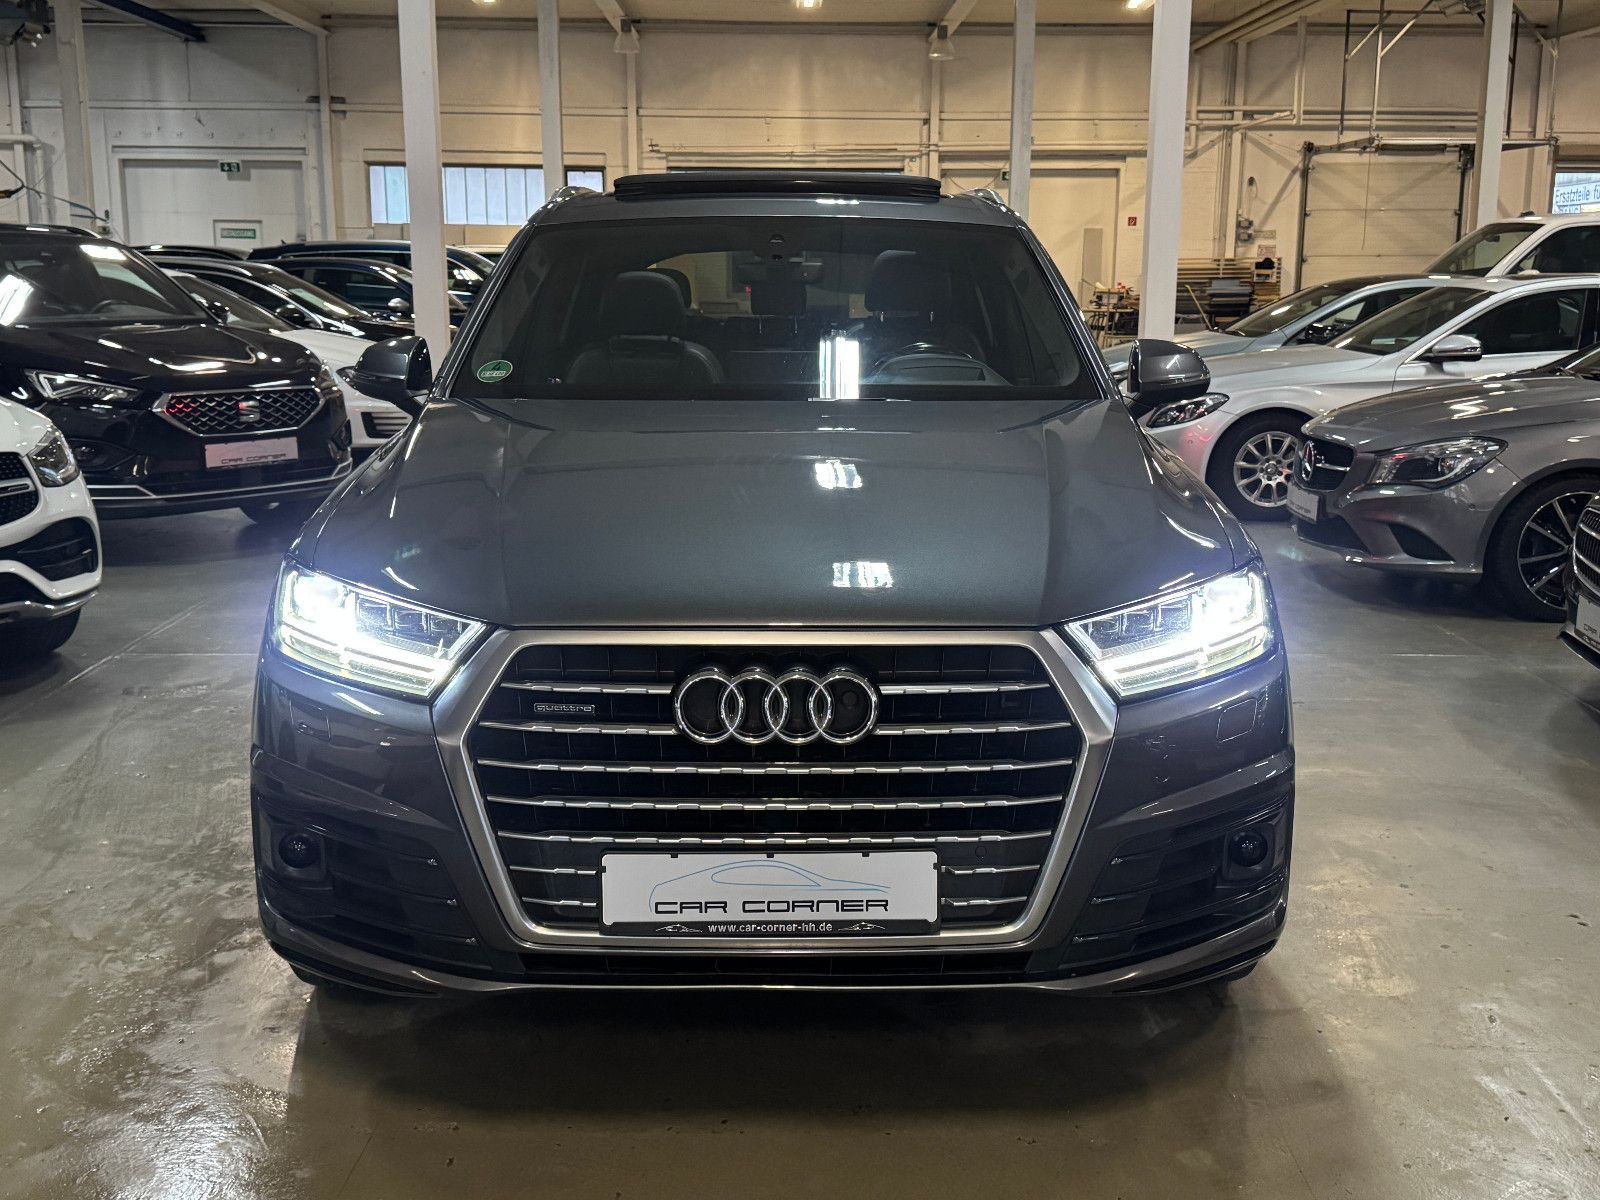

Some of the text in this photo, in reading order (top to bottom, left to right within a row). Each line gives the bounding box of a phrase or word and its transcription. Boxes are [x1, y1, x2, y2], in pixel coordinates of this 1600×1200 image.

[1555, 186, 1590, 204] Ersatzteile
[536, 704, 592, 712] quattro
[654, 899, 889, 914] CAR CORNER
[707, 921, 833, 933] www.car-corner-hh.de
